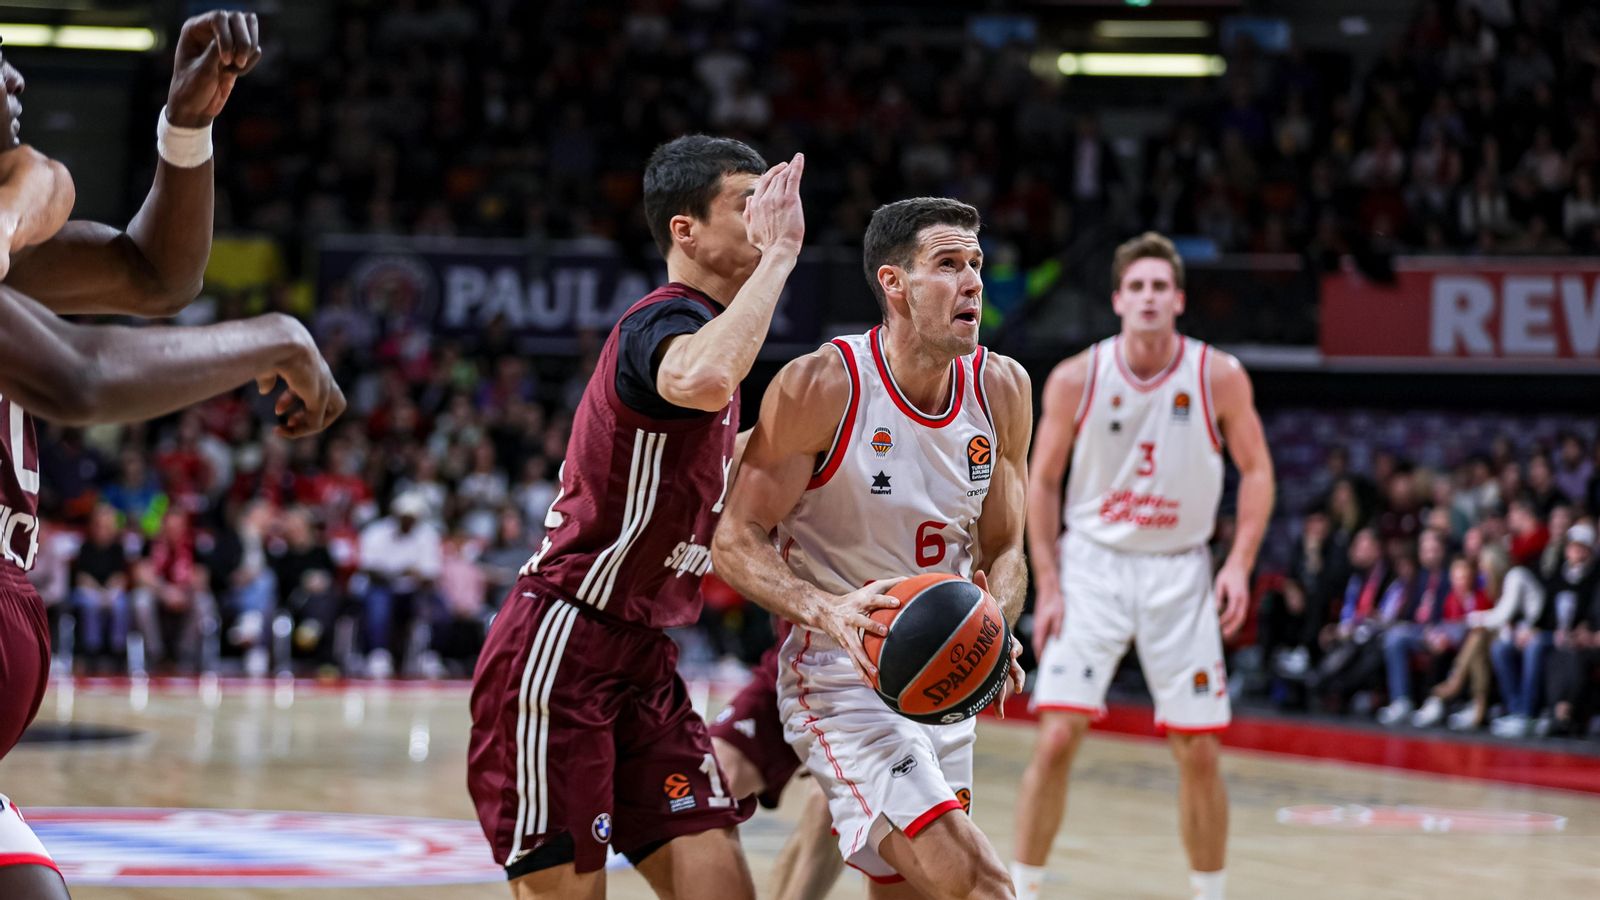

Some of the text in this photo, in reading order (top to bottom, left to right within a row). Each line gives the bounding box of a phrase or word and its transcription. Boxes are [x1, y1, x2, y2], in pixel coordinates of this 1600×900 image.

[1136, 442, 1155, 476] 3
[915, 520, 948, 568] 6
[923, 614, 1001, 706] SPALDING
[698, 752, 739, 809] 1
